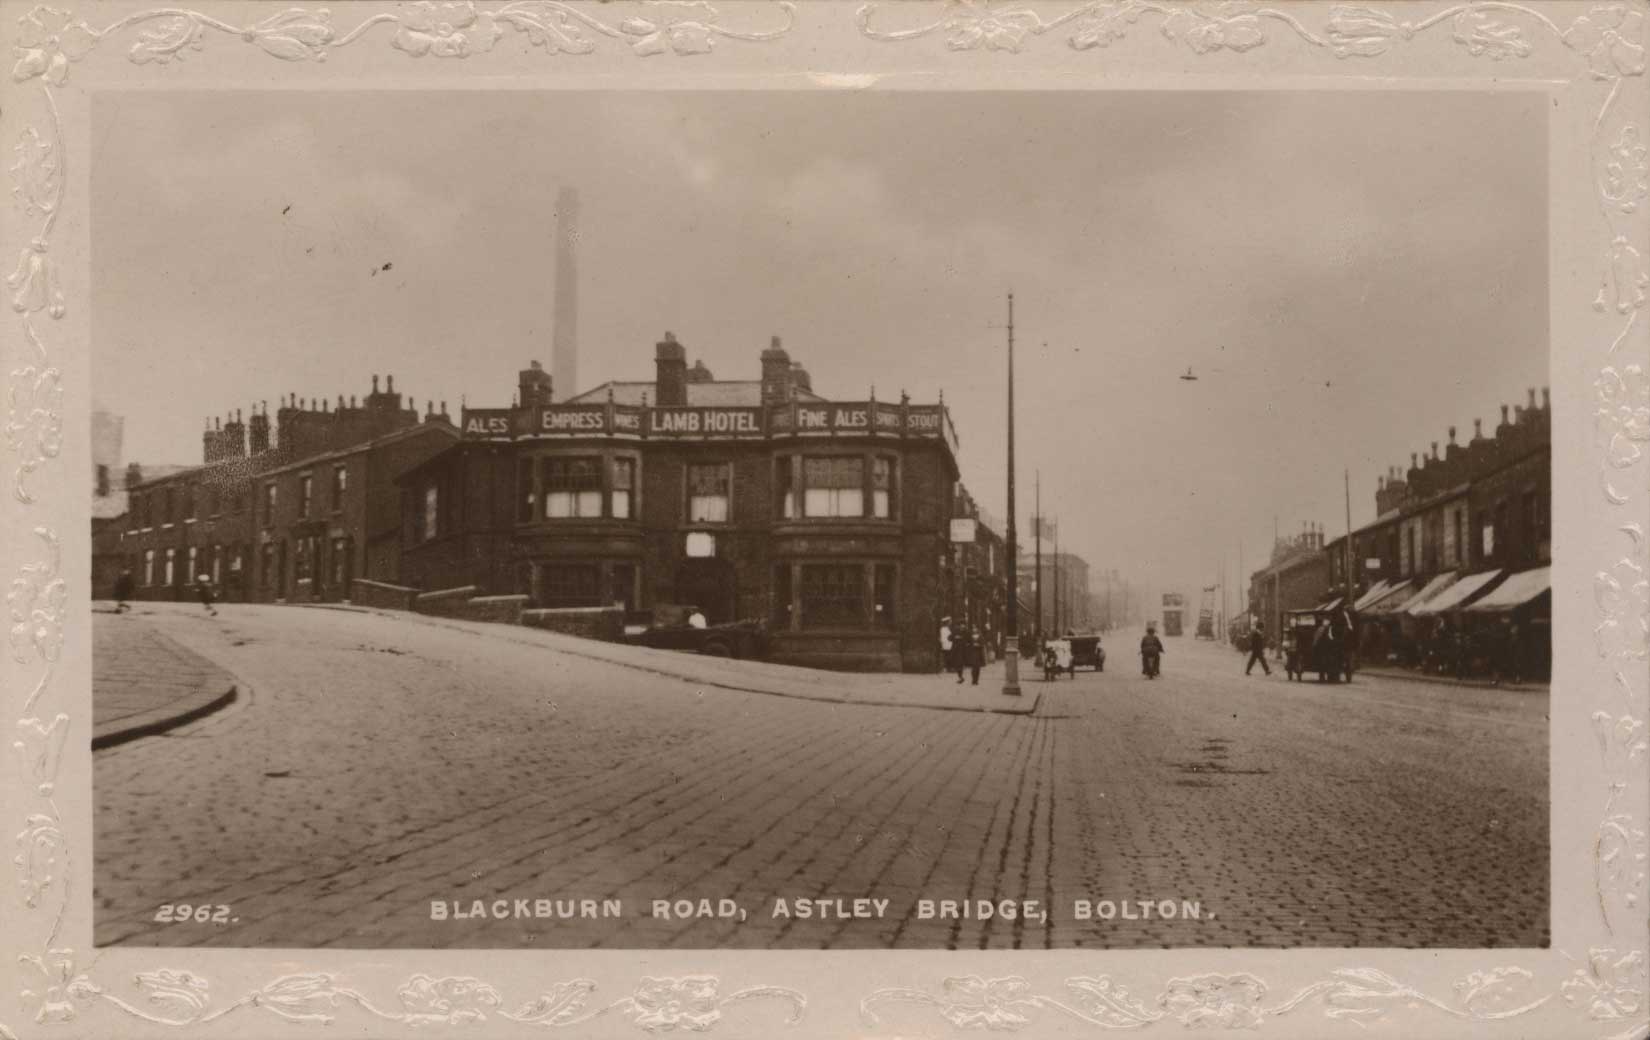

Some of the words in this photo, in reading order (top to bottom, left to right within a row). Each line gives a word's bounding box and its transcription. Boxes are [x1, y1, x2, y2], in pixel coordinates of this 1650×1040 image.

[466, 417, 508, 432] ALES
[543, 411, 603, 429] EMPRESS
[651, 412, 700, 432] LAMB
[703, 412, 758, 432] HOTEL
[798, 409, 827, 427] FINE
[835, 410, 868, 427] ALES
[907, 414, 939, 428] STOUT
